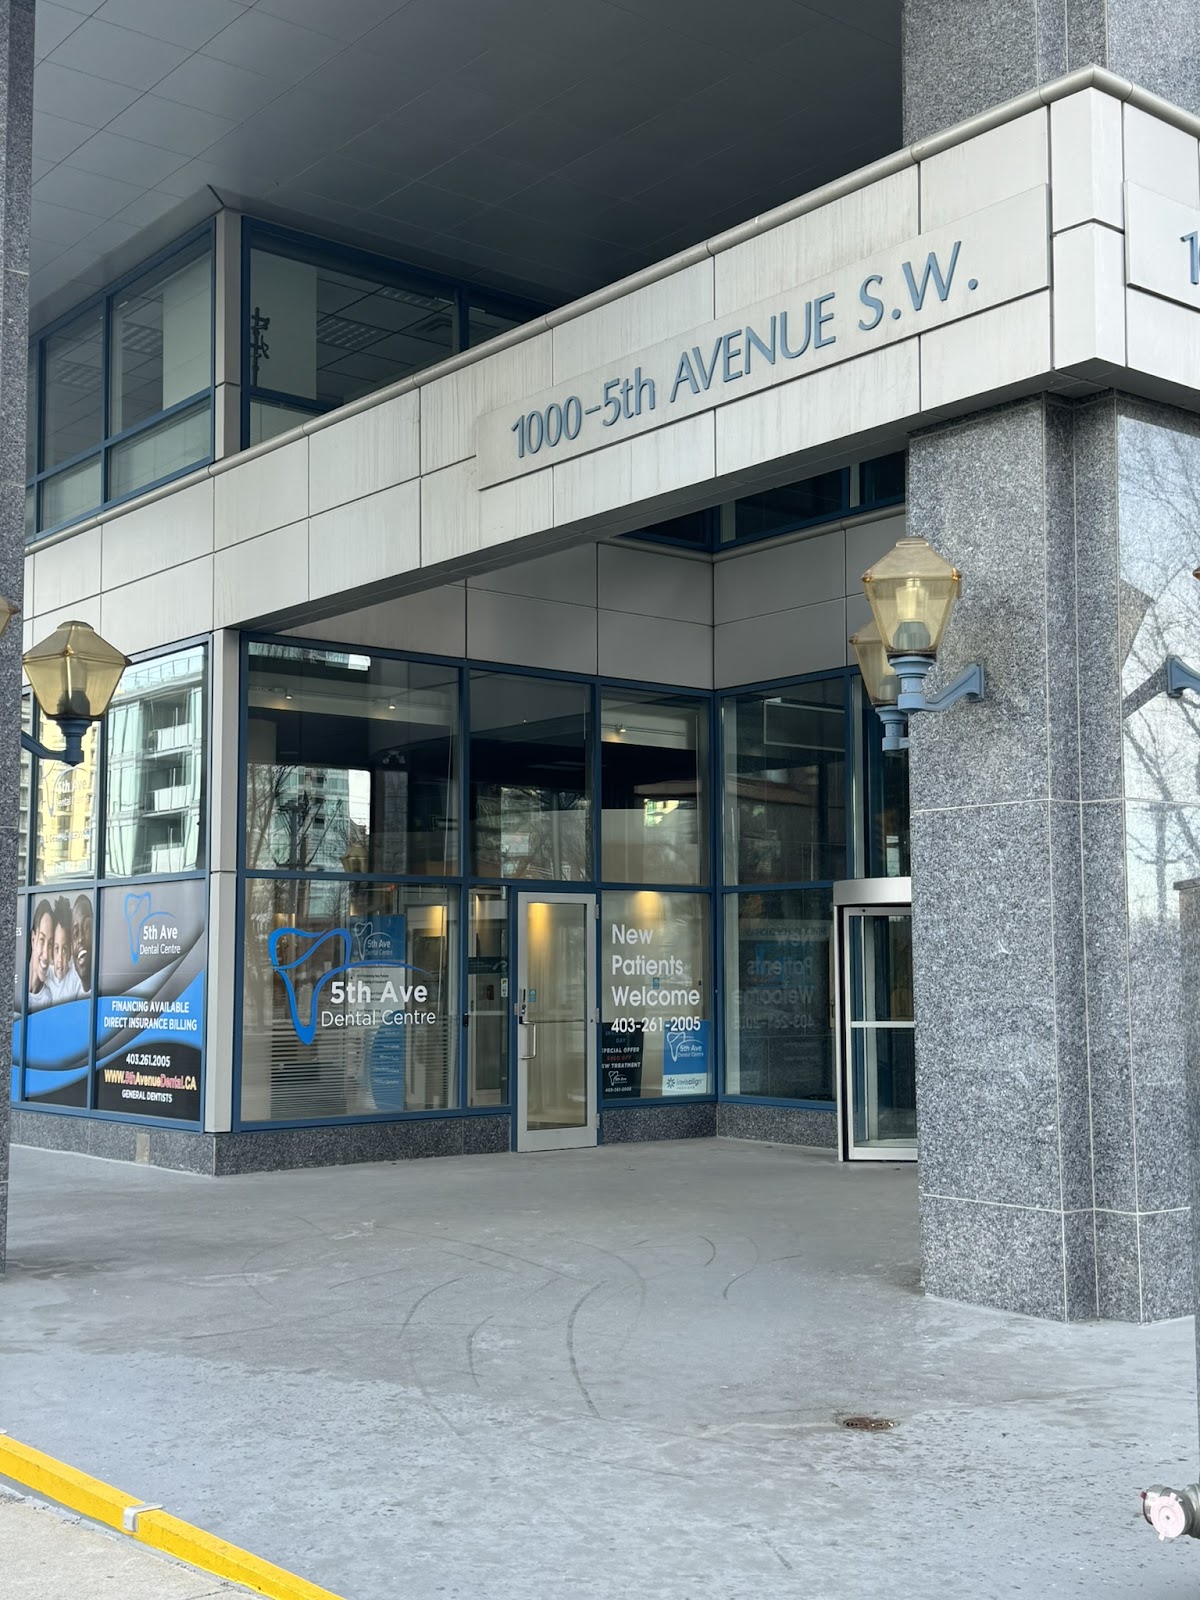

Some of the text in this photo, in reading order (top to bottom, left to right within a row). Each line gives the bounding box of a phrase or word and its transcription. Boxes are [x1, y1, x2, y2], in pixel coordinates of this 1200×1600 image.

[511, 240, 979, 458] 1000-5th AVENUE S.W.
[143, 925, 178, 940] 5th Ave
[611, 924, 653, 945] New
[140, 944, 181, 955] Dental Centre
[367, 939, 391, 948] 5th Ave
[611, 955, 683, 976] Patients
[330, 981, 428, 1004] 5th Ave
[611, 985, 700, 1007] Welcome
[111, 1001, 189, 1013] FINANCING AVAILABLE
[104, 1016, 197, 1031] DIRECT INSURANCE BILLING
[321, 1009, 436, 1027] Dental Centre
[611, 1016, 701, 1033] 403-261-2005
[126, 1053, 171, 1067] 403.261.2005
[121, 1089, 173, 1103] GENERAL DENTISTS
